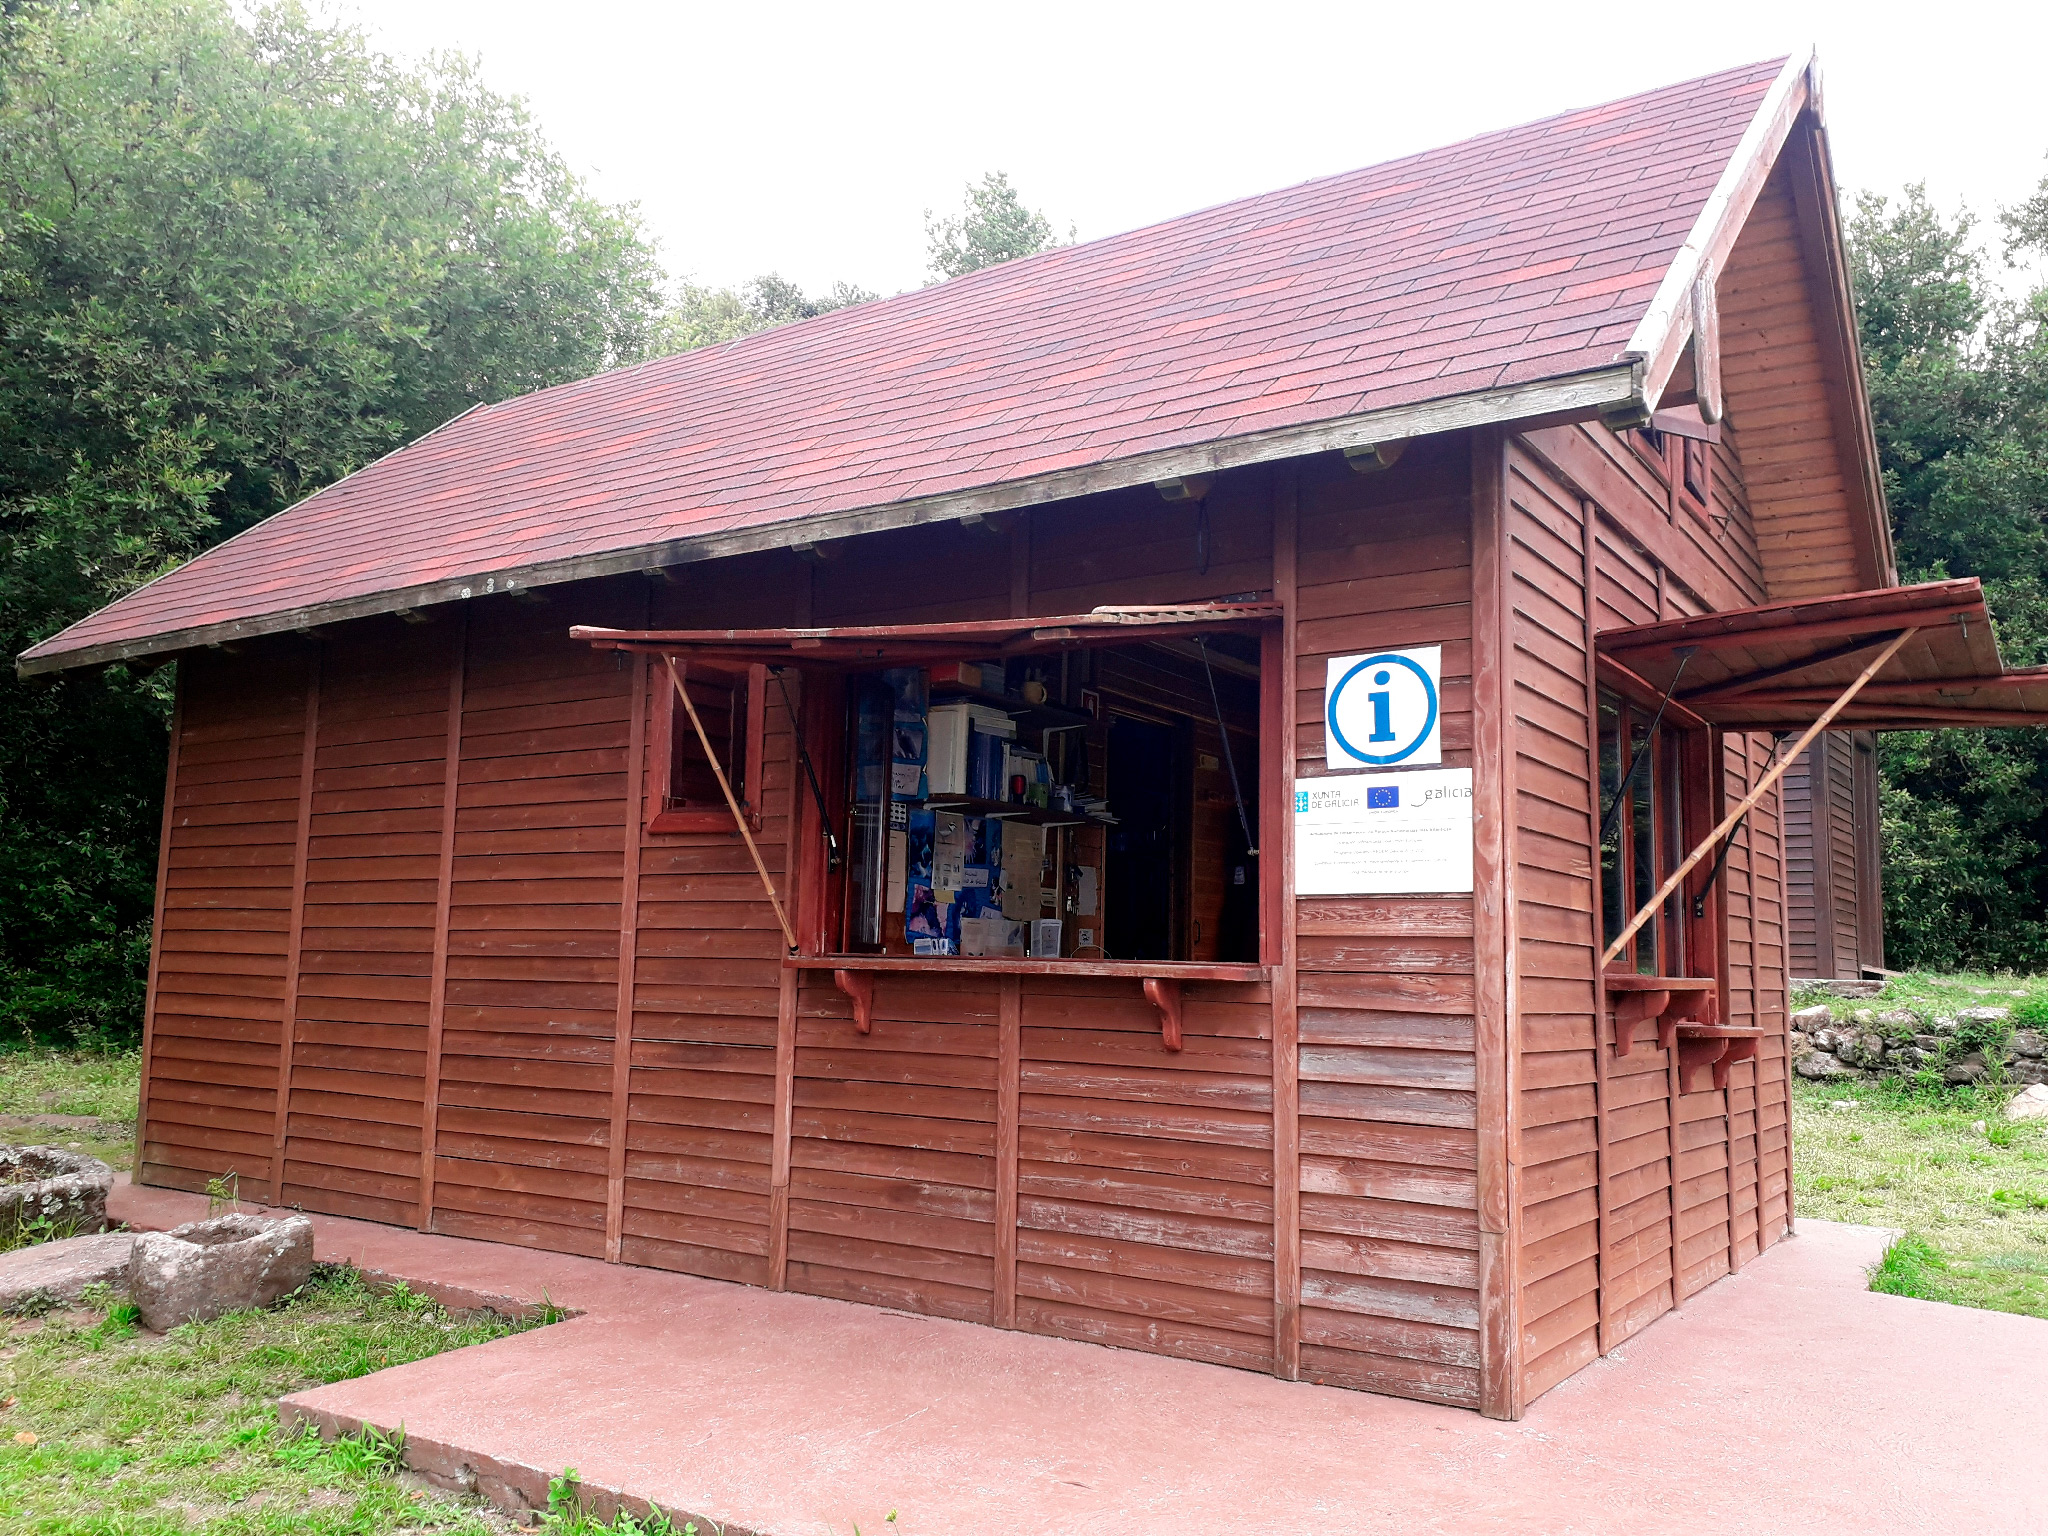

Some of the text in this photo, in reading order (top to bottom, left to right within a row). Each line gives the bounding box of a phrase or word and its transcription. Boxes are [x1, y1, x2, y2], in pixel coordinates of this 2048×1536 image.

[1368, 670, 1396, 743] i
[1311, 798, 1360, 809] DE GALICIA
[1312, 790, 1341, 800] XUNTA
[1411, 785, 1473, 808] galicia
